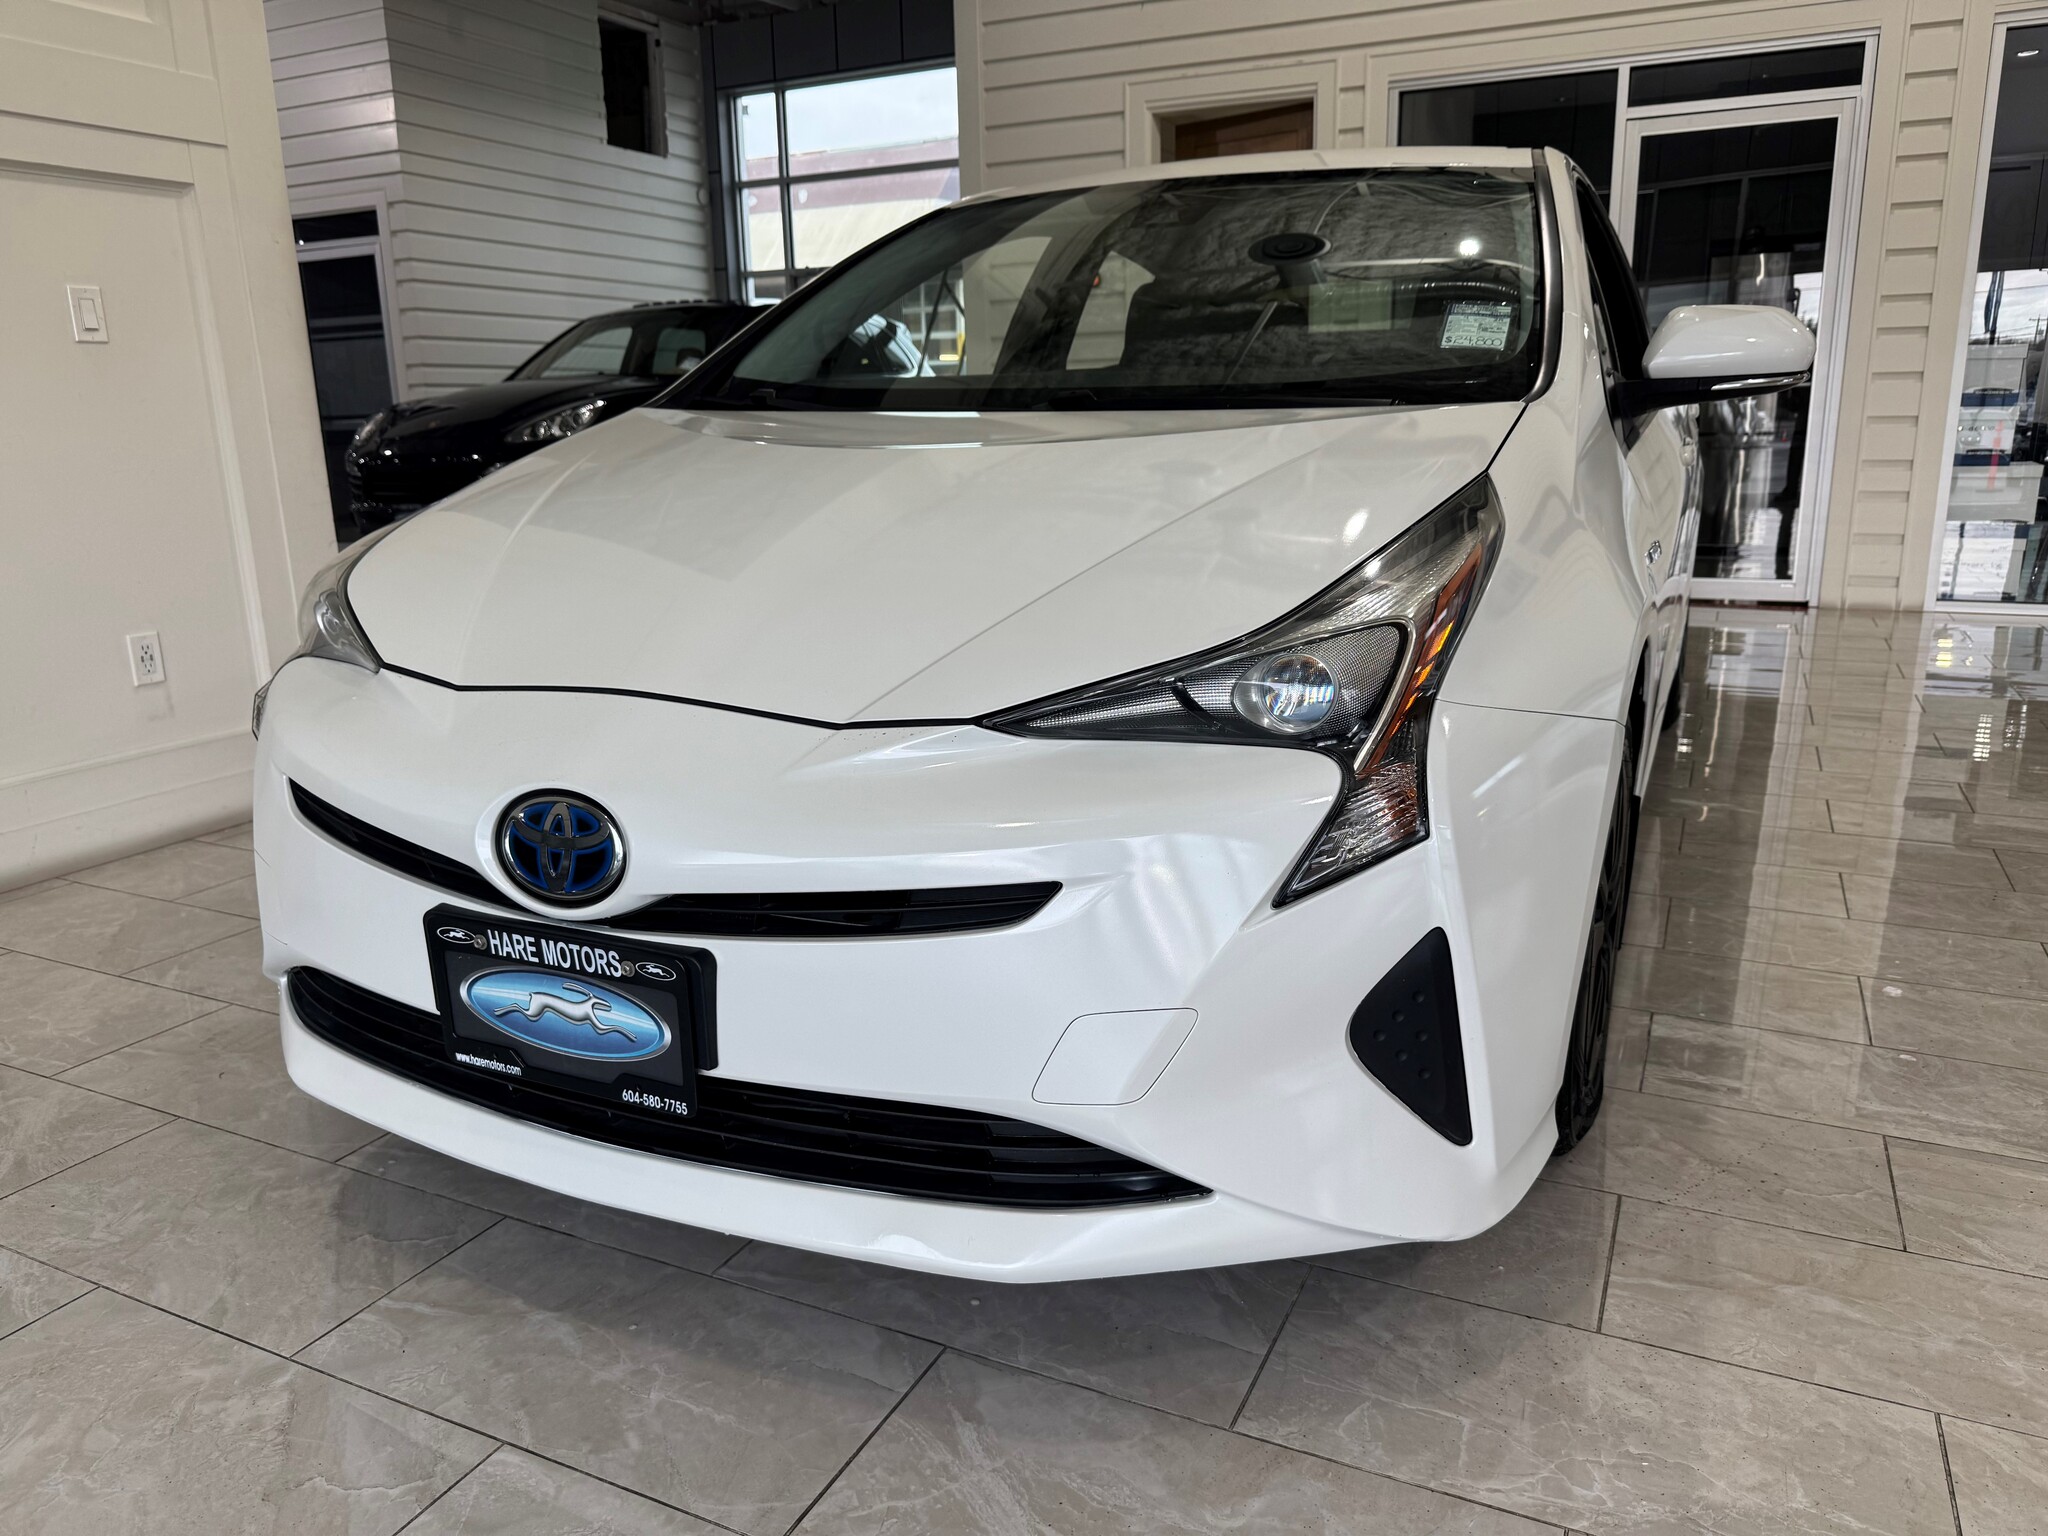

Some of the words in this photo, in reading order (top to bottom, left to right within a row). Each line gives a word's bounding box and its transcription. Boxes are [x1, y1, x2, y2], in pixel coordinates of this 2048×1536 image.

[1444, 335, 1503, 347] $24,800
[487, 929, 539, 963] HARE
[541, 938, 622, 978] MOTORS
[455, 1052, 522, 1076] www.haremotors.com
[622, 1089, 688, 1115] 604-580-7755
